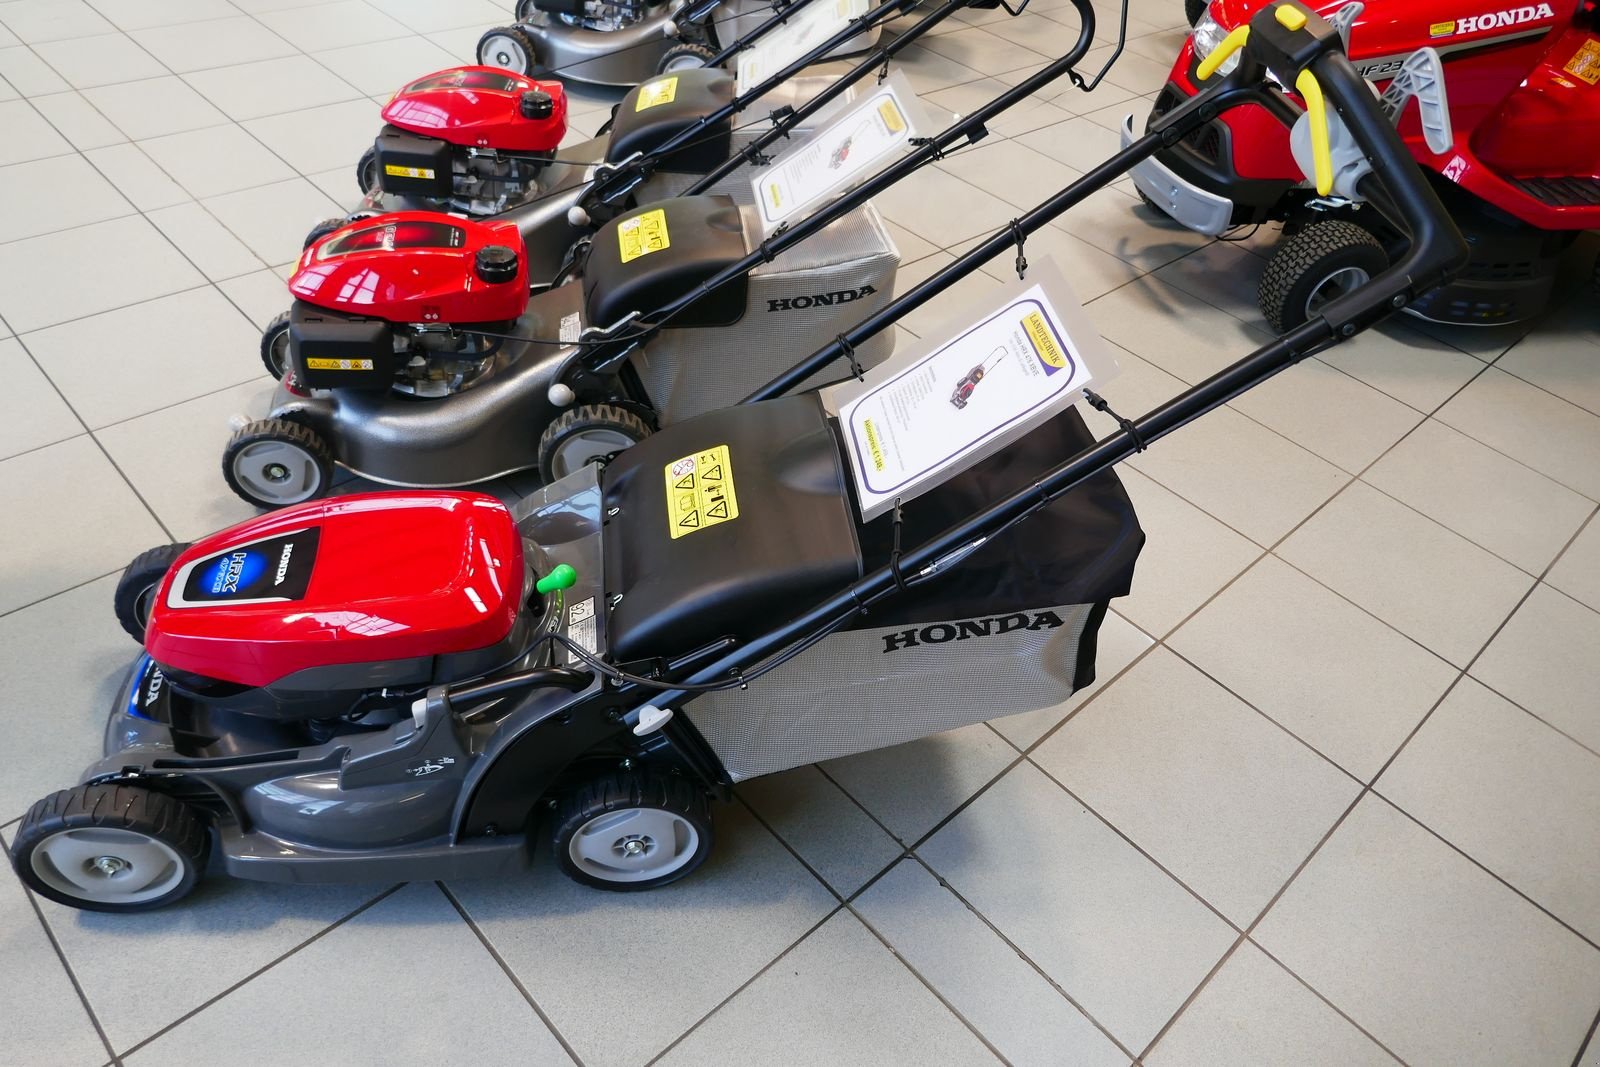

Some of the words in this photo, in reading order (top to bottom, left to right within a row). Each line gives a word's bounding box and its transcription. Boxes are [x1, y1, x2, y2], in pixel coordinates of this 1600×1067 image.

[1456, 2, 1554, 35] HONDA
[767, 284, 878, 313] HONDA
[1030, 314, 1060, 364] LANDTECHNIK
[222, 552, 247, 593] HRX
[274, 543, 294, 586] HONDA
[570, 603, 585, 618] 92
[882, 610, 1065, 654] HONDA
[145, 667, 164, 707] NDA
